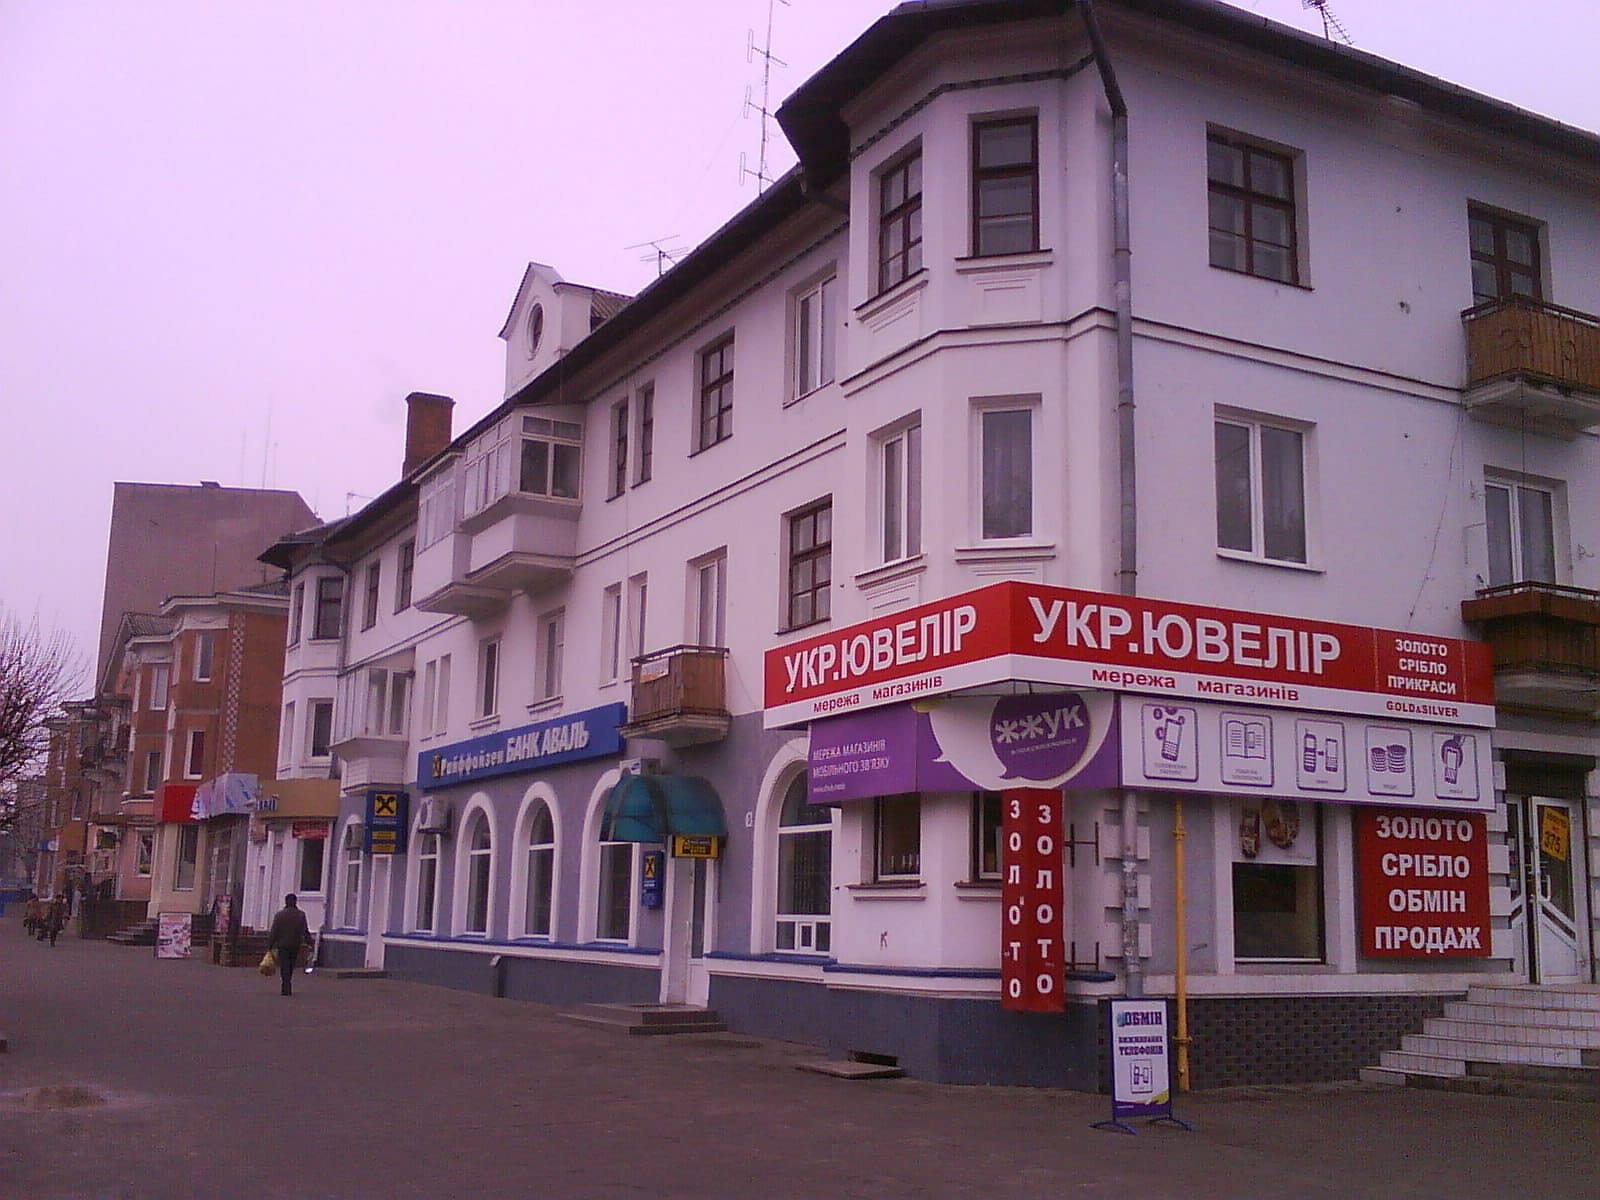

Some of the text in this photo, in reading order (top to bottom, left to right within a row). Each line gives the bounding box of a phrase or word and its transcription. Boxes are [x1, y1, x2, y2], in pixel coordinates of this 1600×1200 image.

[784, 604, 976, 692] УКР.ЮВЕЛІР
[1027, 596, 1342, 675] УКР.ЮВЕЛІР
[1395, 639, 1448, 657] ЗОЛОТО
[1399, 658, 1447, 675] СРІБЛО
[813, 674, 943, 712] мережа магазинів
[1092, 668, 1300, 702] мережа магазинів
[1387, 674, 1457, 695] ПРИКРАСИ
[506, 735, 541, 763] БАНК
[541, 721, 588, 754] АВАЛЬ
[1376, 815, 1473, 842] ЗОЛОТО
[1381, 853, 1470, 878] СРІБЛО
[1036, 804, 1053, 995] ЗОЛОТО
[1388, 889, 1466, 913] ОБМІН
[1375, 926, 1481, 954] ПРОДАЖ
[1124, 1011, 1162, 1025] ОБМІН
